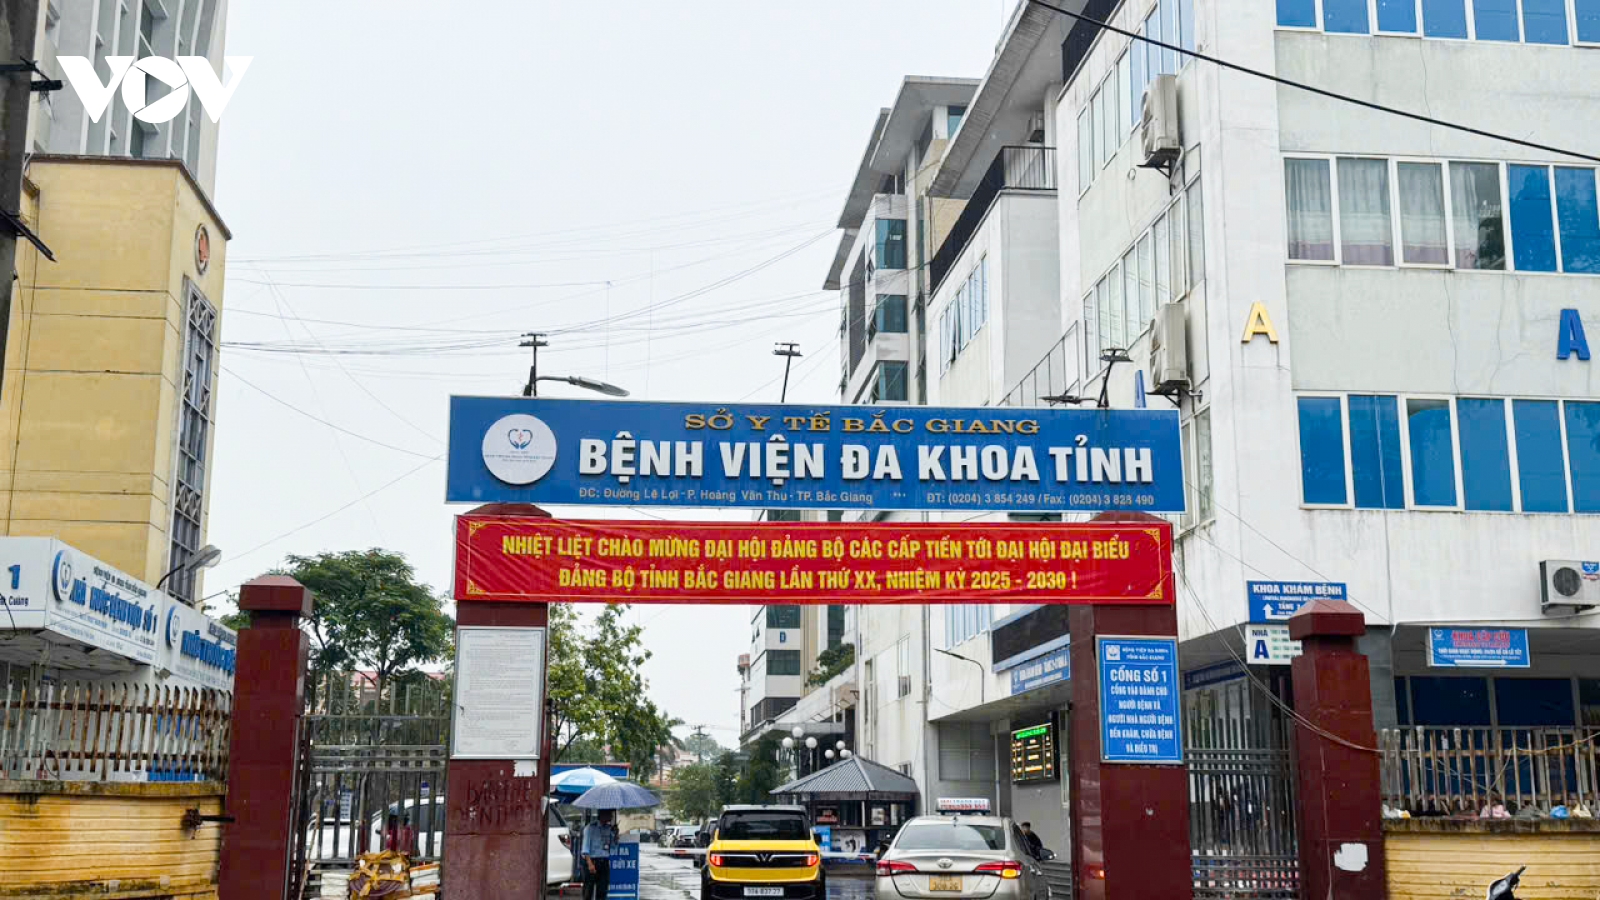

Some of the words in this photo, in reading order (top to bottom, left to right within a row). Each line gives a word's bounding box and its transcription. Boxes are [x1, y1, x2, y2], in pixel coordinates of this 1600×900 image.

[1242, 302, 1279, 344] A
[1557, 308, 1590, 361] A
[685, 407, 734, 431] SỞ
[745, 416, 771, 431] Y
[783, 409, 831, 432] TẾ
[841, 410, 914, 434] BẮC
[925, 418, 1041, 435] GIANG
[579, 430, 703, 484] BỆNH
[719, 433, 825, 485] VIỆN
[840, 444, 904, 480] ĐA
[918, 445, 1041, 481] KHOA
[1049, 434, 1154, 483] TỈNH
[700, 489, 736, 502] Hoàng
[840, 491, 873, 504] Giang
[949, 493, 980, 505] (0204)
[985, 495, 991, 504] 3
[994, 494, 1012, 504] 854
[1016, 494, 1035, 504] 249
[1044, 494, 1065, 505] Fax:
[1070, 494, 1101, 506] (0204)
[1104, 495, 1110, 505] 3
[1135, 495, 1155, 505] 490
[502, 534, 554, 560] NHIỆT
[558, 535, 593, 560] LIỆT
[597, 534, 644, 558] CHÀO
[648, 534, 700, 559] MỪNG
[704, 538, 733, 562] ĐẠI
[737, 536, 766, 563] HỘI
[771, 533, 817, 559] ĐẢNG
[823, 538, 845, 562] BỘ
[849, 534, 883, 560] CÁC
[887, 534, 921, 560] CẤP
[925, 534, 962, 560] TIẾN
[965, 536, 993, 560] TỚI
[997, 540, 1025, 562] ĐẠI
[1028, 537, 1056, 563] HỘI
[1060, 540, 1089, 562] ĐẠI
[1092, 534, 1130, 560] BIỂU
[9, 565, 20, 590] 1
[559, 562, 607, 589] ĐẢNG
[612, 565, 635, 593] BỘ
[638, 563, 680, 590] TỈNH
[684, 563, 719, 590] BẮC
[723, 568, 775, 591] GIANG
[780, 562, 813, 590] LẦN
[817, 567, 850, 590] THỨ
[854, 571, 882, 592] XX,
[886, 568, 941, 594] NHIỆM
[945, 567, 966, 590] KỲ
[970, 570, 1011, 590] 2025
[1026, 571, 1067, 590] 2030
[1070, 571, 1077, 589] !
[1252, 584, 1280, 594] KHOA
[1283, 583, 1313, 595] KHÁM
[1315, 583, 1342, 597] BỆNH
[1254, 639, 1270, 659] A
[1143, 665, 1159, 683] SỐ
[1162, 671, 1167, 682] 1
